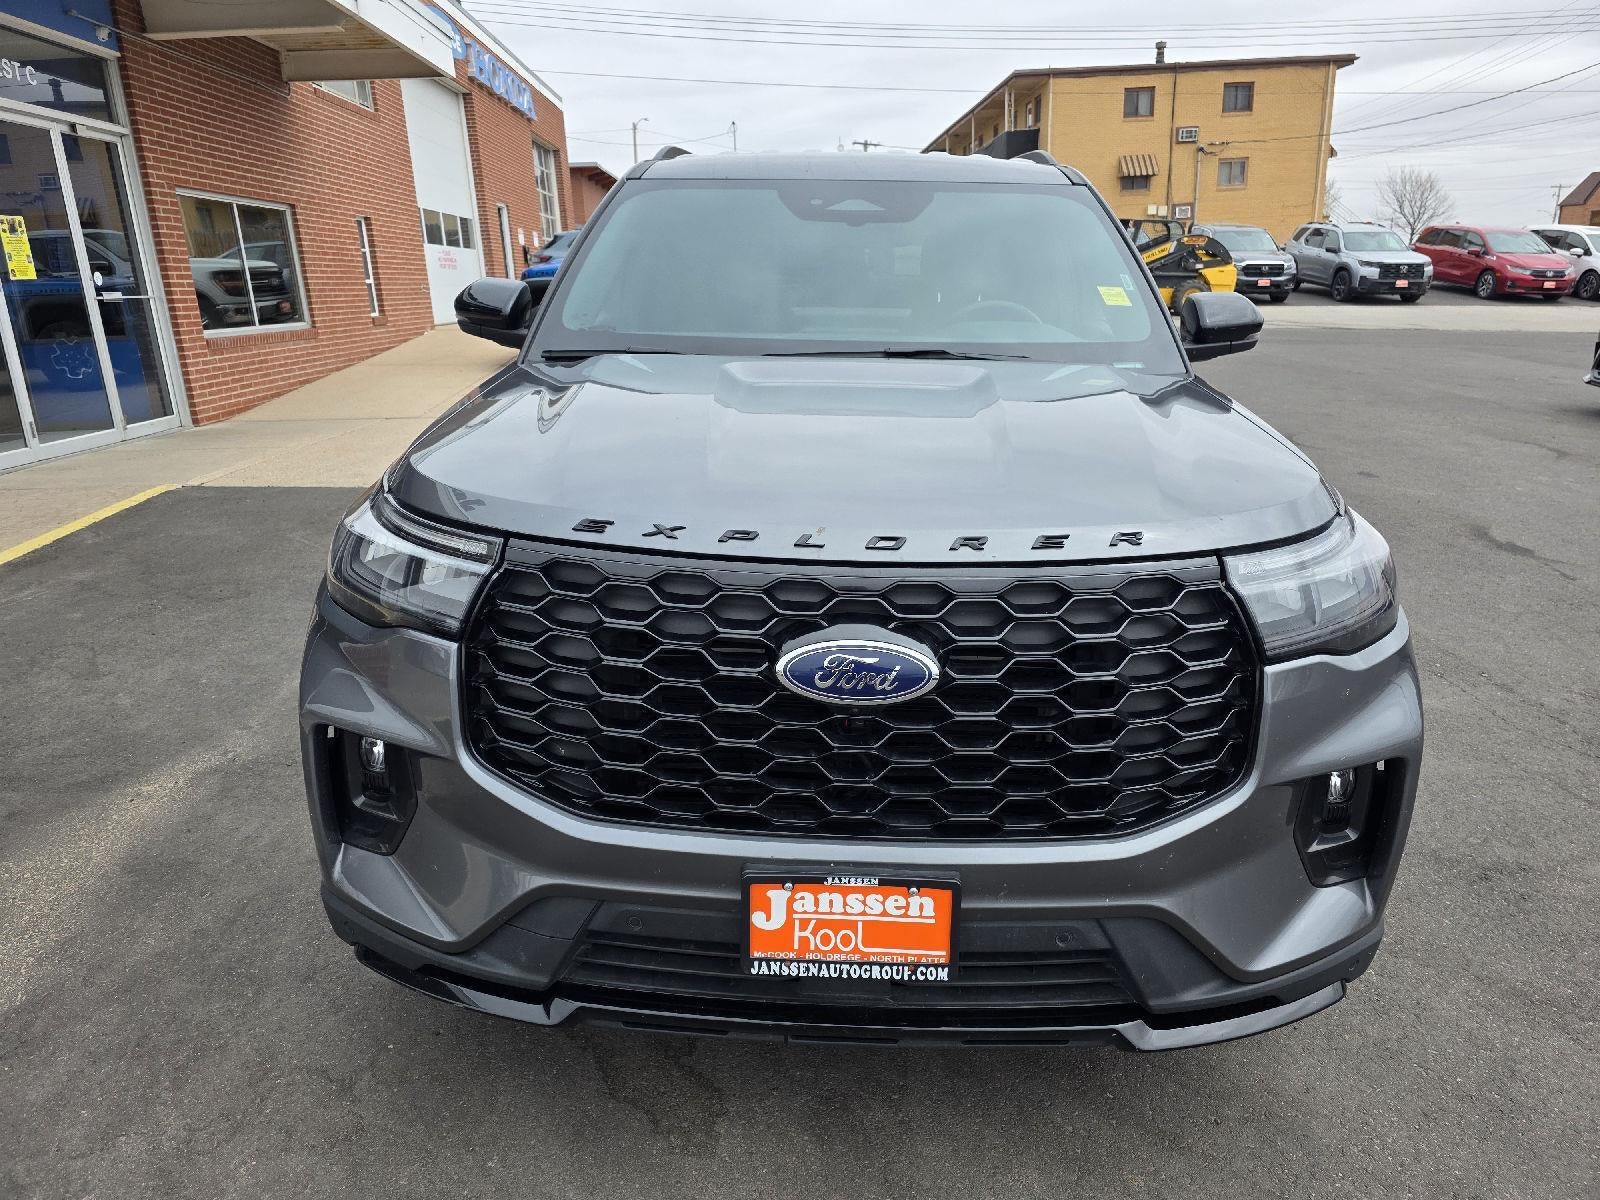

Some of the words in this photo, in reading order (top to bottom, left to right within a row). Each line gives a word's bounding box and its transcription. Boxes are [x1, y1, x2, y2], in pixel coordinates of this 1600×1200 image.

[572, 518, 1144, 551] EXPLORER
[815, 653, 901, 691] Ford
[823, 877, 879, 886] JANSSEN
[751, 889, 935, 930] Janssen
[869, 955, 905, 963] NORTH
